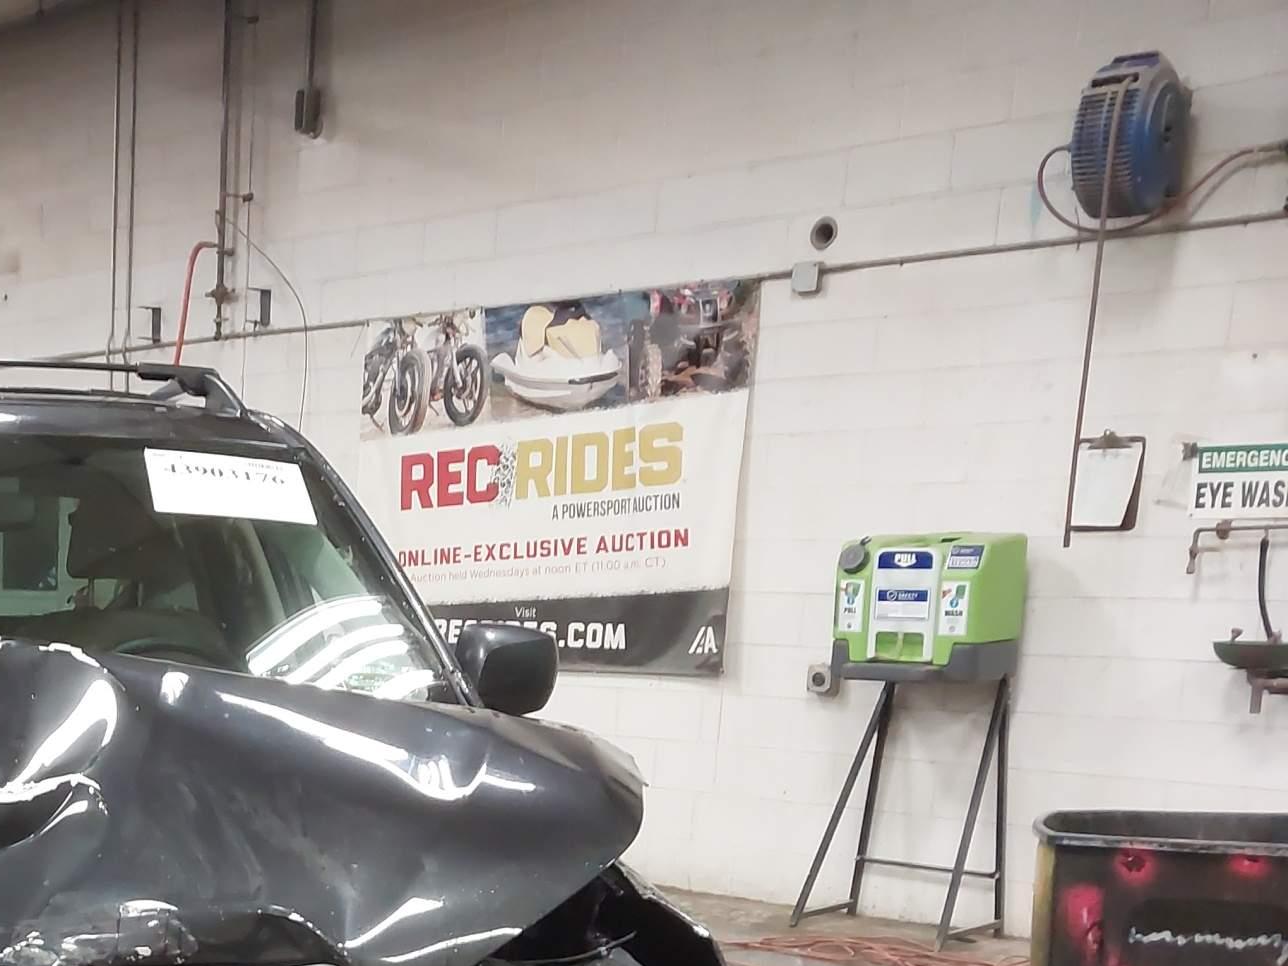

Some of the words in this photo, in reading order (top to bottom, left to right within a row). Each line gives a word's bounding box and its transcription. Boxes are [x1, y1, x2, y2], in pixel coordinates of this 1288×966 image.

[400, 444, 501, 511] REC
[515, 421, 684, 500] RIDES
[552, 504, 559, 520] A
[631, 492, 680, 514] AUCTION
[1194, 481, 1234, 509] EYE
[1241, 480, 1288, 508] WAS
[398, 536, 588, 568] ONLINE-EXCLUSIVE
[595, 528, 689, 554] AUCTION
[448, 570, 468, 580] held
[544, 564, 572, 576] noon
[514, 606, 537, 618] Visit
